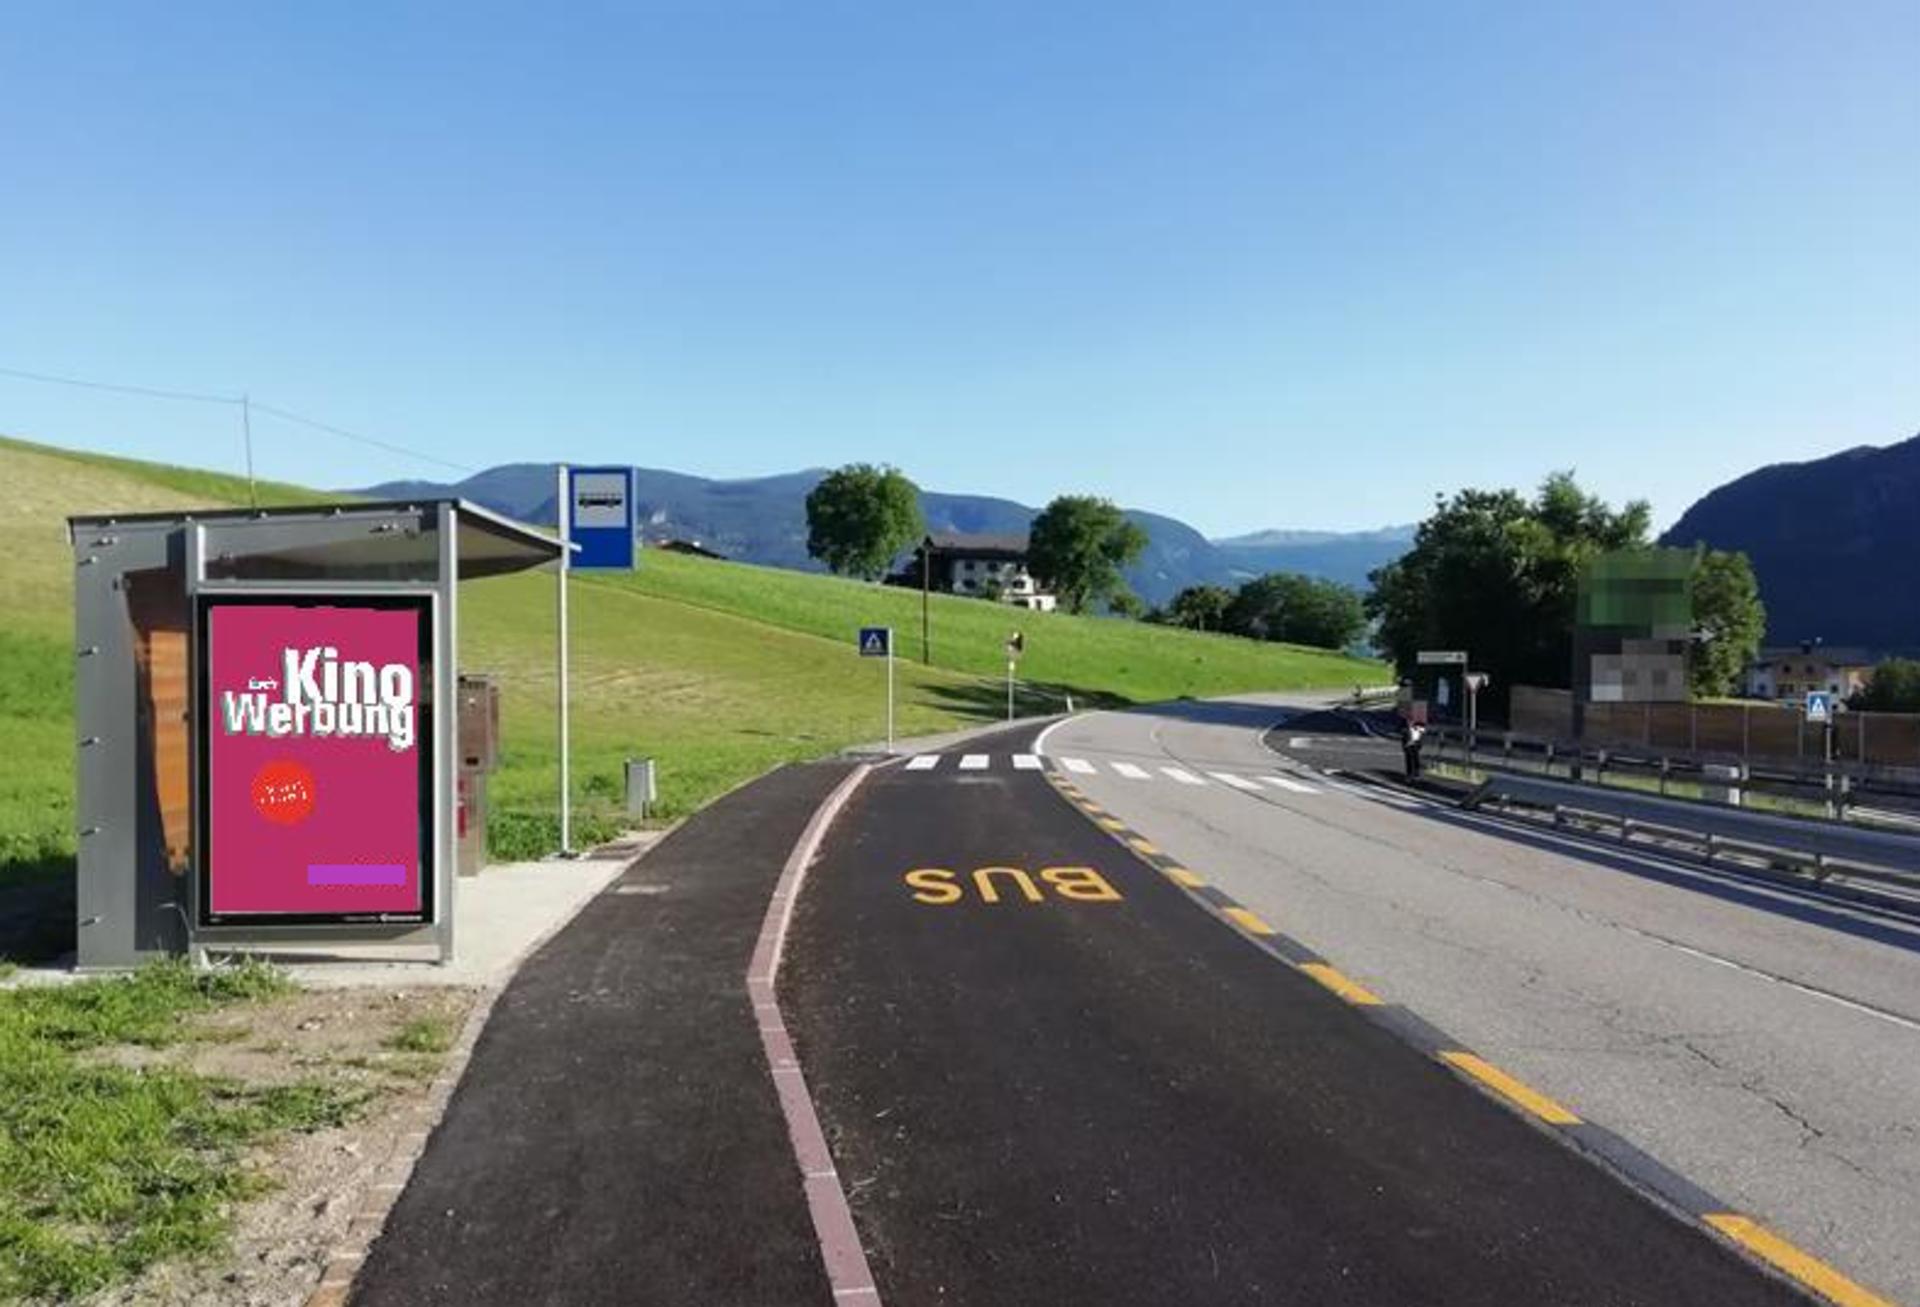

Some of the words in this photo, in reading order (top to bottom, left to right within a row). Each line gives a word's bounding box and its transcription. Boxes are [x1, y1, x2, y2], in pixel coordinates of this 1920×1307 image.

[283, 646, 413, 706] Kino
[222, 690, 415, 750] Werbung
[904, 866, 1123, 904] BUS
